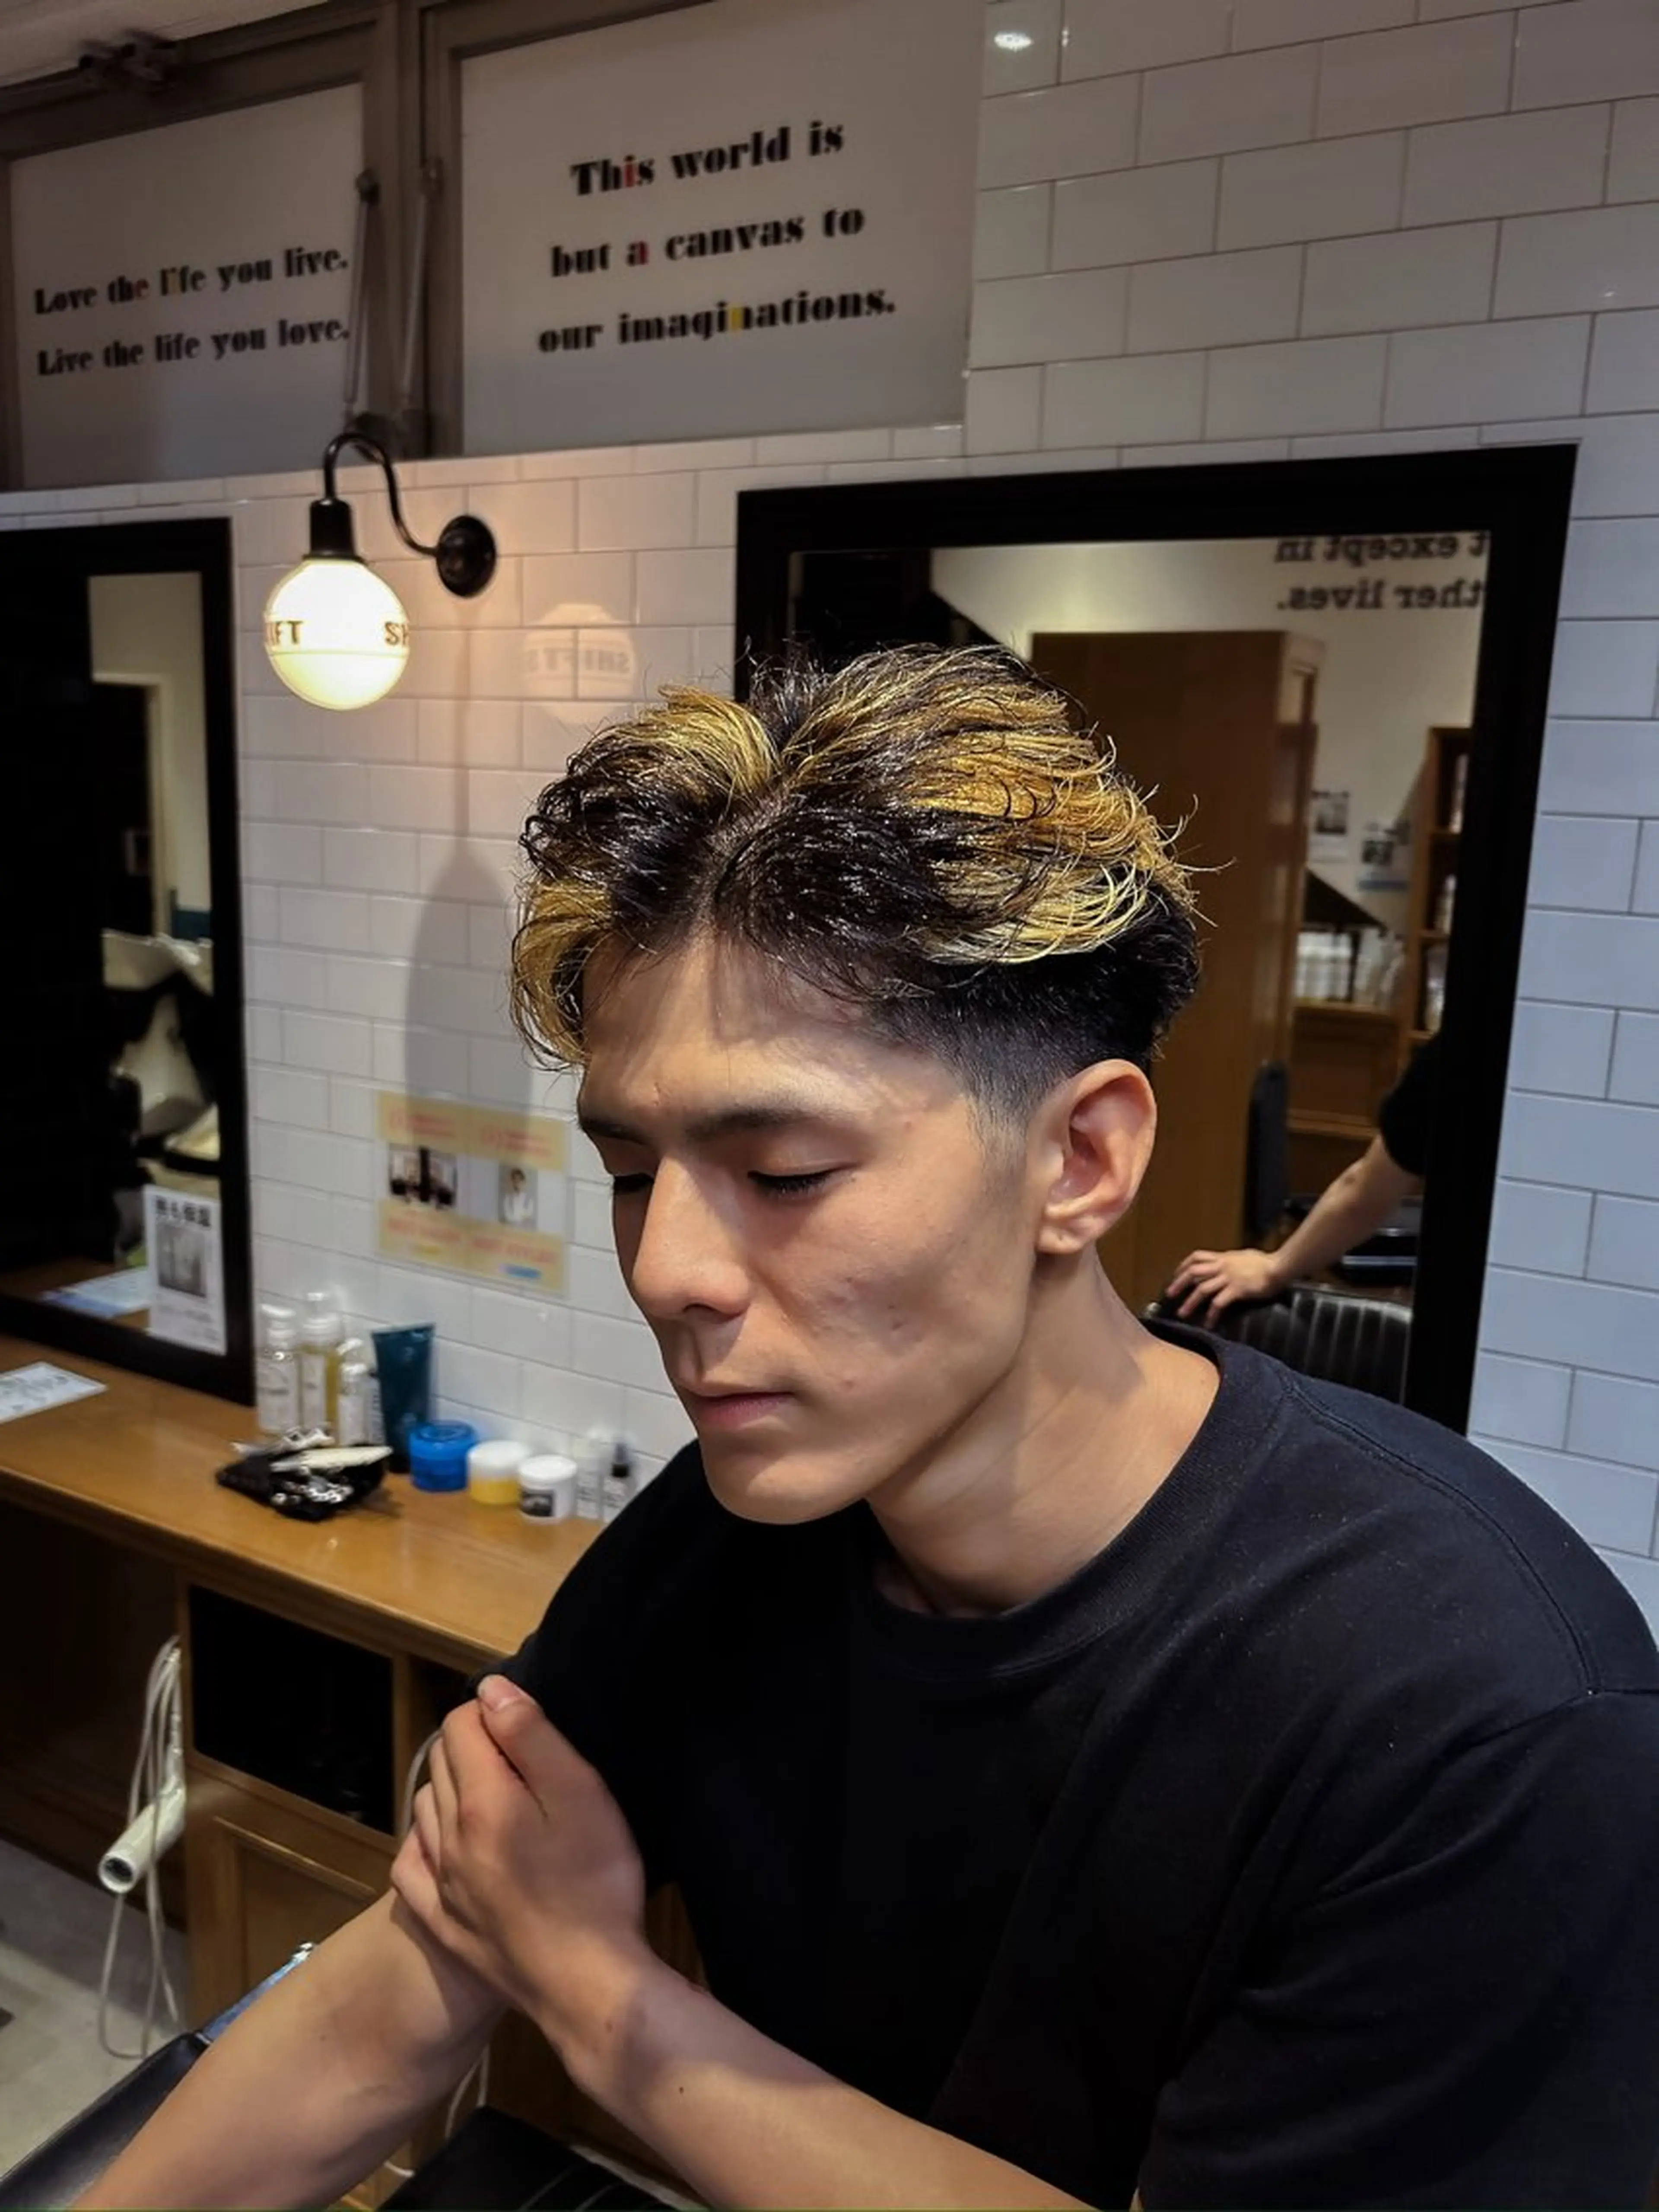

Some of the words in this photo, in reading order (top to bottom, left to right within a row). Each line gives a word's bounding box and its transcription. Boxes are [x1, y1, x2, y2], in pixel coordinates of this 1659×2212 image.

[570, 155, 654, 196] This
[671, 126, 790, 179] world
[809, 121, 843, 156] is
[551, 244, 610, 277] but
[626, 241, 648, 267] a
[665, 217, 804, 261] canvas
[823, 209, 864, 237] to
[34, 288, 97, 315] Love
[107, 275, 149, 304] the
[159, 265, 206, 296] life
[216, 259, 273, 292] you
[284, 246, 348, 278] live.
[37, 349, 93, 376] Live
[103, 340, 143, 368] the
[154, 333, 200, 362] life
[210, 328, 266, 359] you
[278, 319, 349, 347] love.
[538, 325, 602, 353] our
[619, 290, 895, 344] imaginations.
